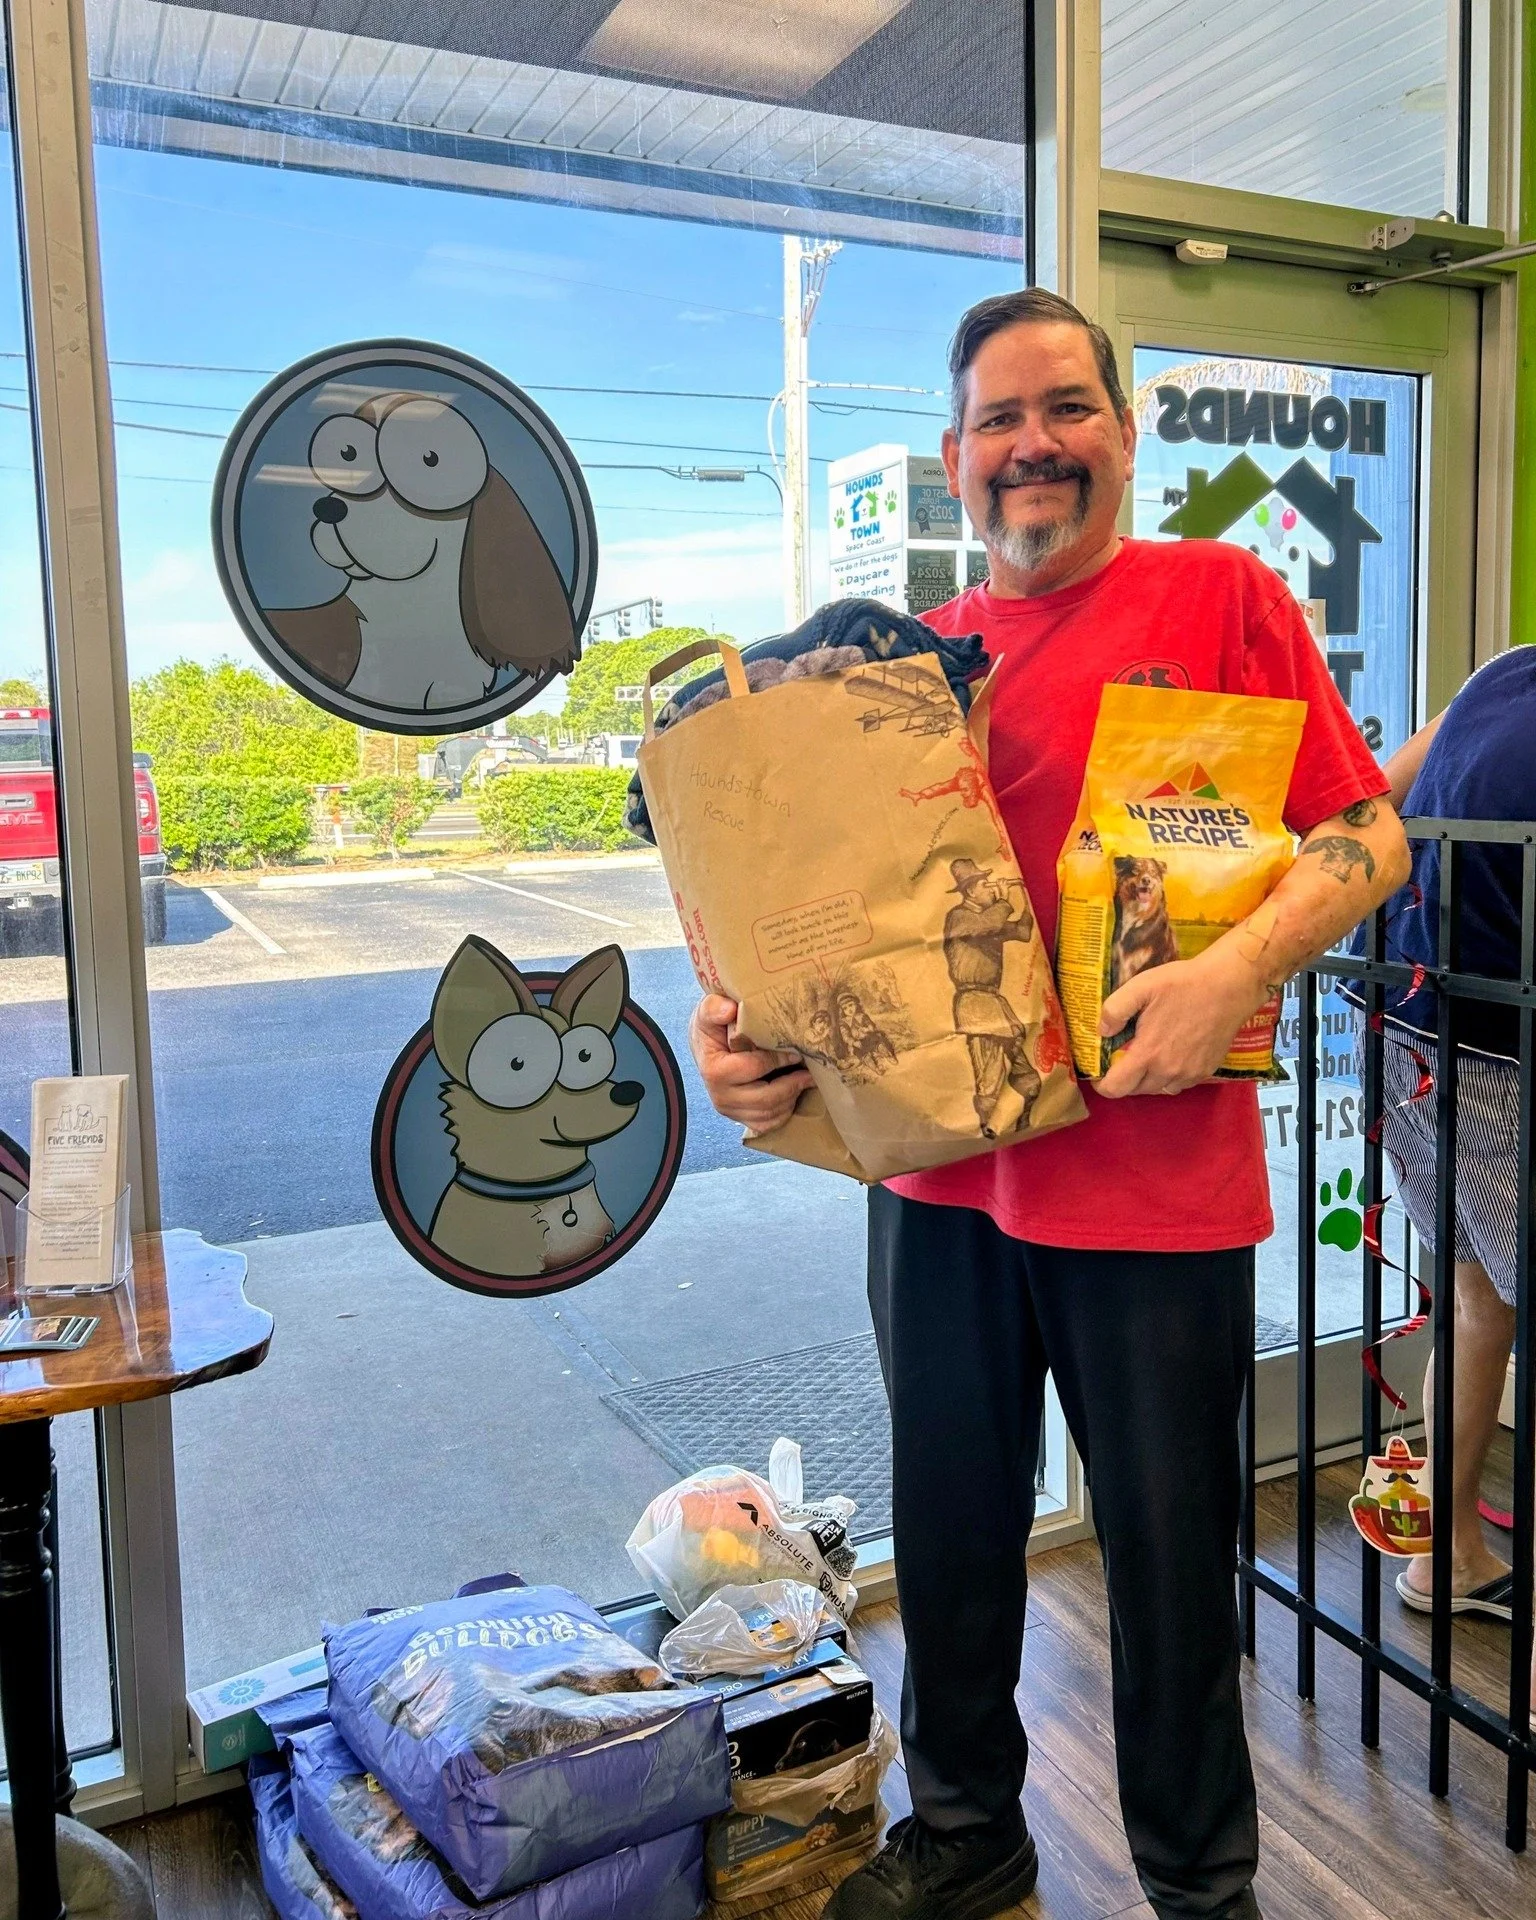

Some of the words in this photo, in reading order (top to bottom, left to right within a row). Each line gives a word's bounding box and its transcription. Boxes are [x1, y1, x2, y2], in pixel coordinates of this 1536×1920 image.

[845, 472, 883, 497] HOUNDS
[850, 521, 880, 541] TOWN
[845, 543, 864, 554] Space
[860, 558, 869, 567] for
[882, 552, 898, 562] dogs
[846, 568, 890, 586] Daycare
[703, 800, 744, 832] Rescue
[1125, 802, 1251, 827] NATURE'S
[784, 928, 799, 937] look
[47, 1135, 65, 1145] FIVE
[67, 1133, 104, 1146] FRIENDS
[763, 1524, 814, 1571] ABSOLUTE
[408, 1611, 572, 1650] Beautiful
[403, 1622, 604, 1680] BULLDOGS
[719, 1682, 743, 1694] PRO
[728, 1813, 765, 1838] PUPPY
